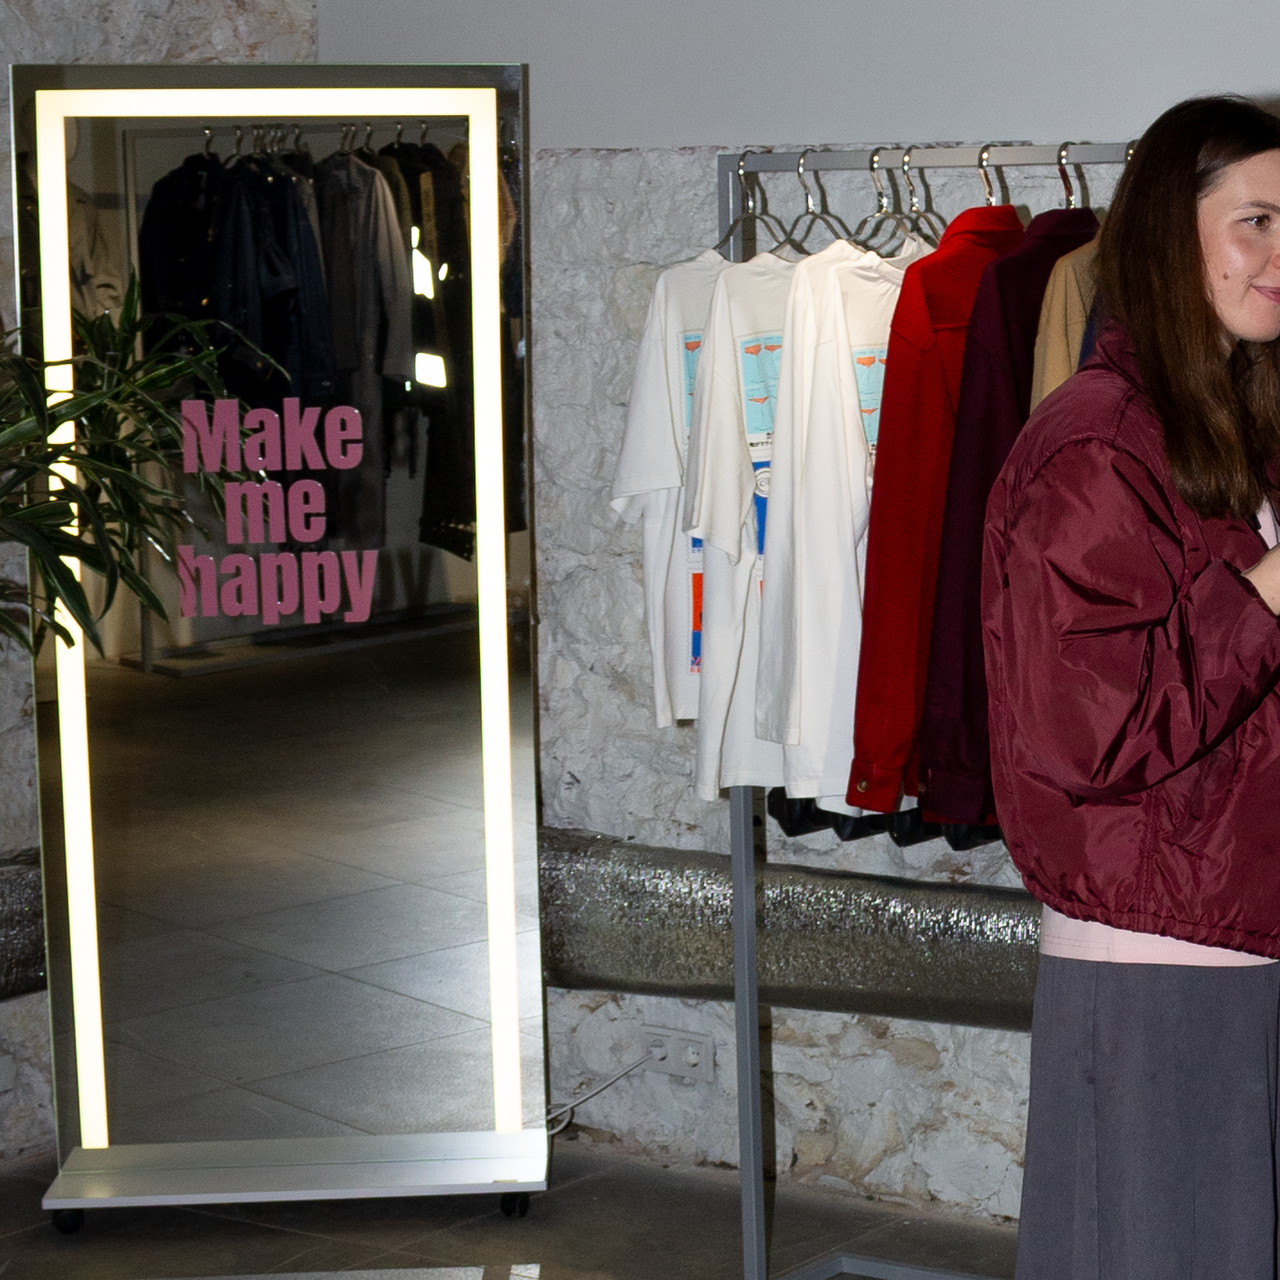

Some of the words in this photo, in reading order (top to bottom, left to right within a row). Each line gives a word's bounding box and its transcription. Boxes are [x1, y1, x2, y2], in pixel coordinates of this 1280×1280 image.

[181, 397, 363, 473] Make
[224, 479, 326, 544] me
[177, 544, 378, 624] happy
